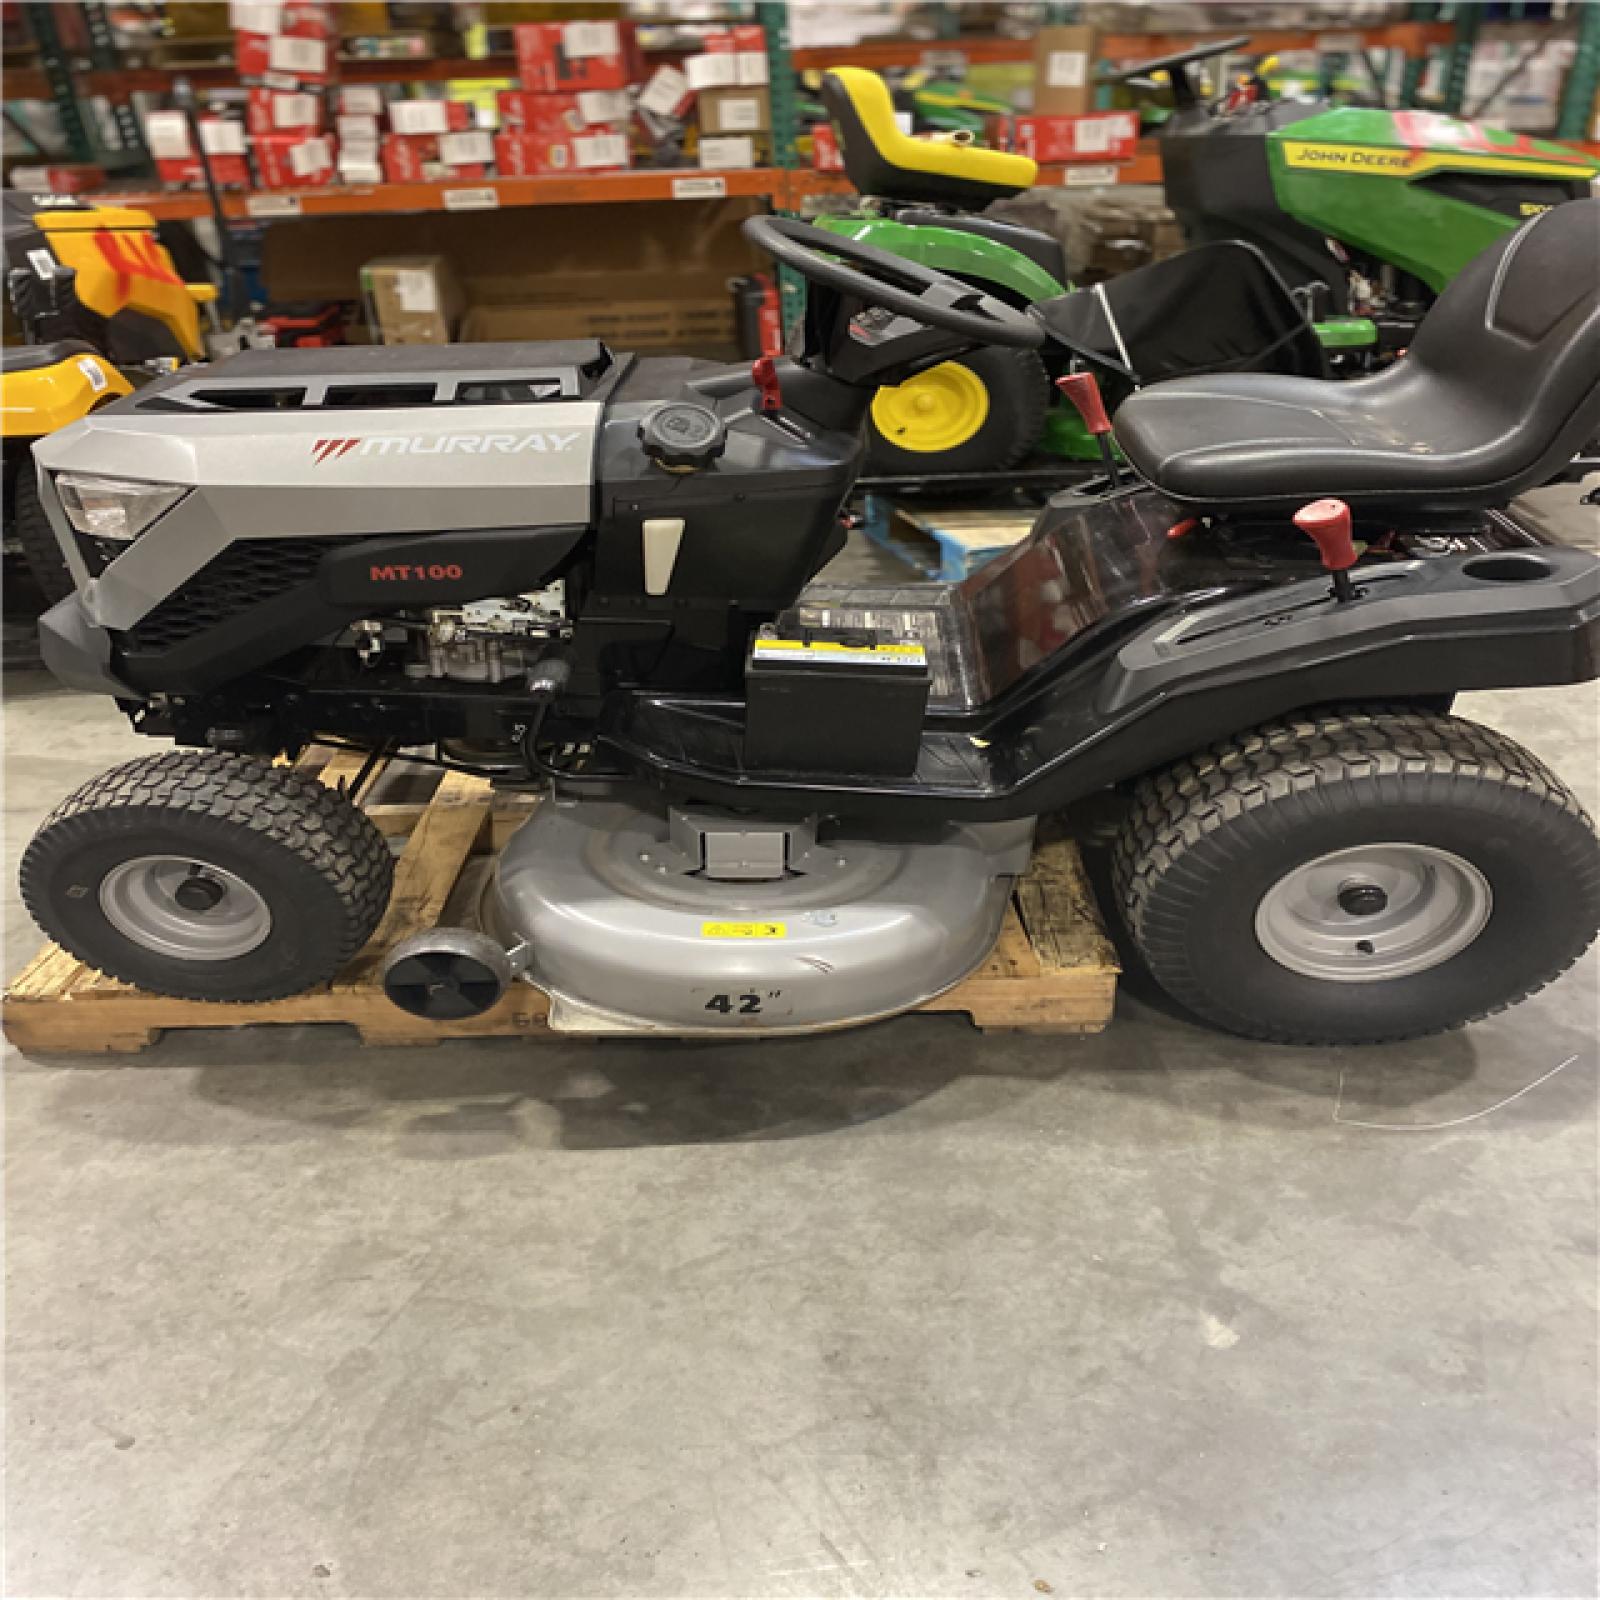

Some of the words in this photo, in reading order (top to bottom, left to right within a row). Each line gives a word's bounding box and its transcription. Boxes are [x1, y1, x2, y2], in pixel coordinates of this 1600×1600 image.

[1296, 148, 1346, 162] JOHN
[1350, 151, 1413, 168] DEERE
[360, 432, 582, 456] MURRAY
[369, 564, 463, 581] MT100
